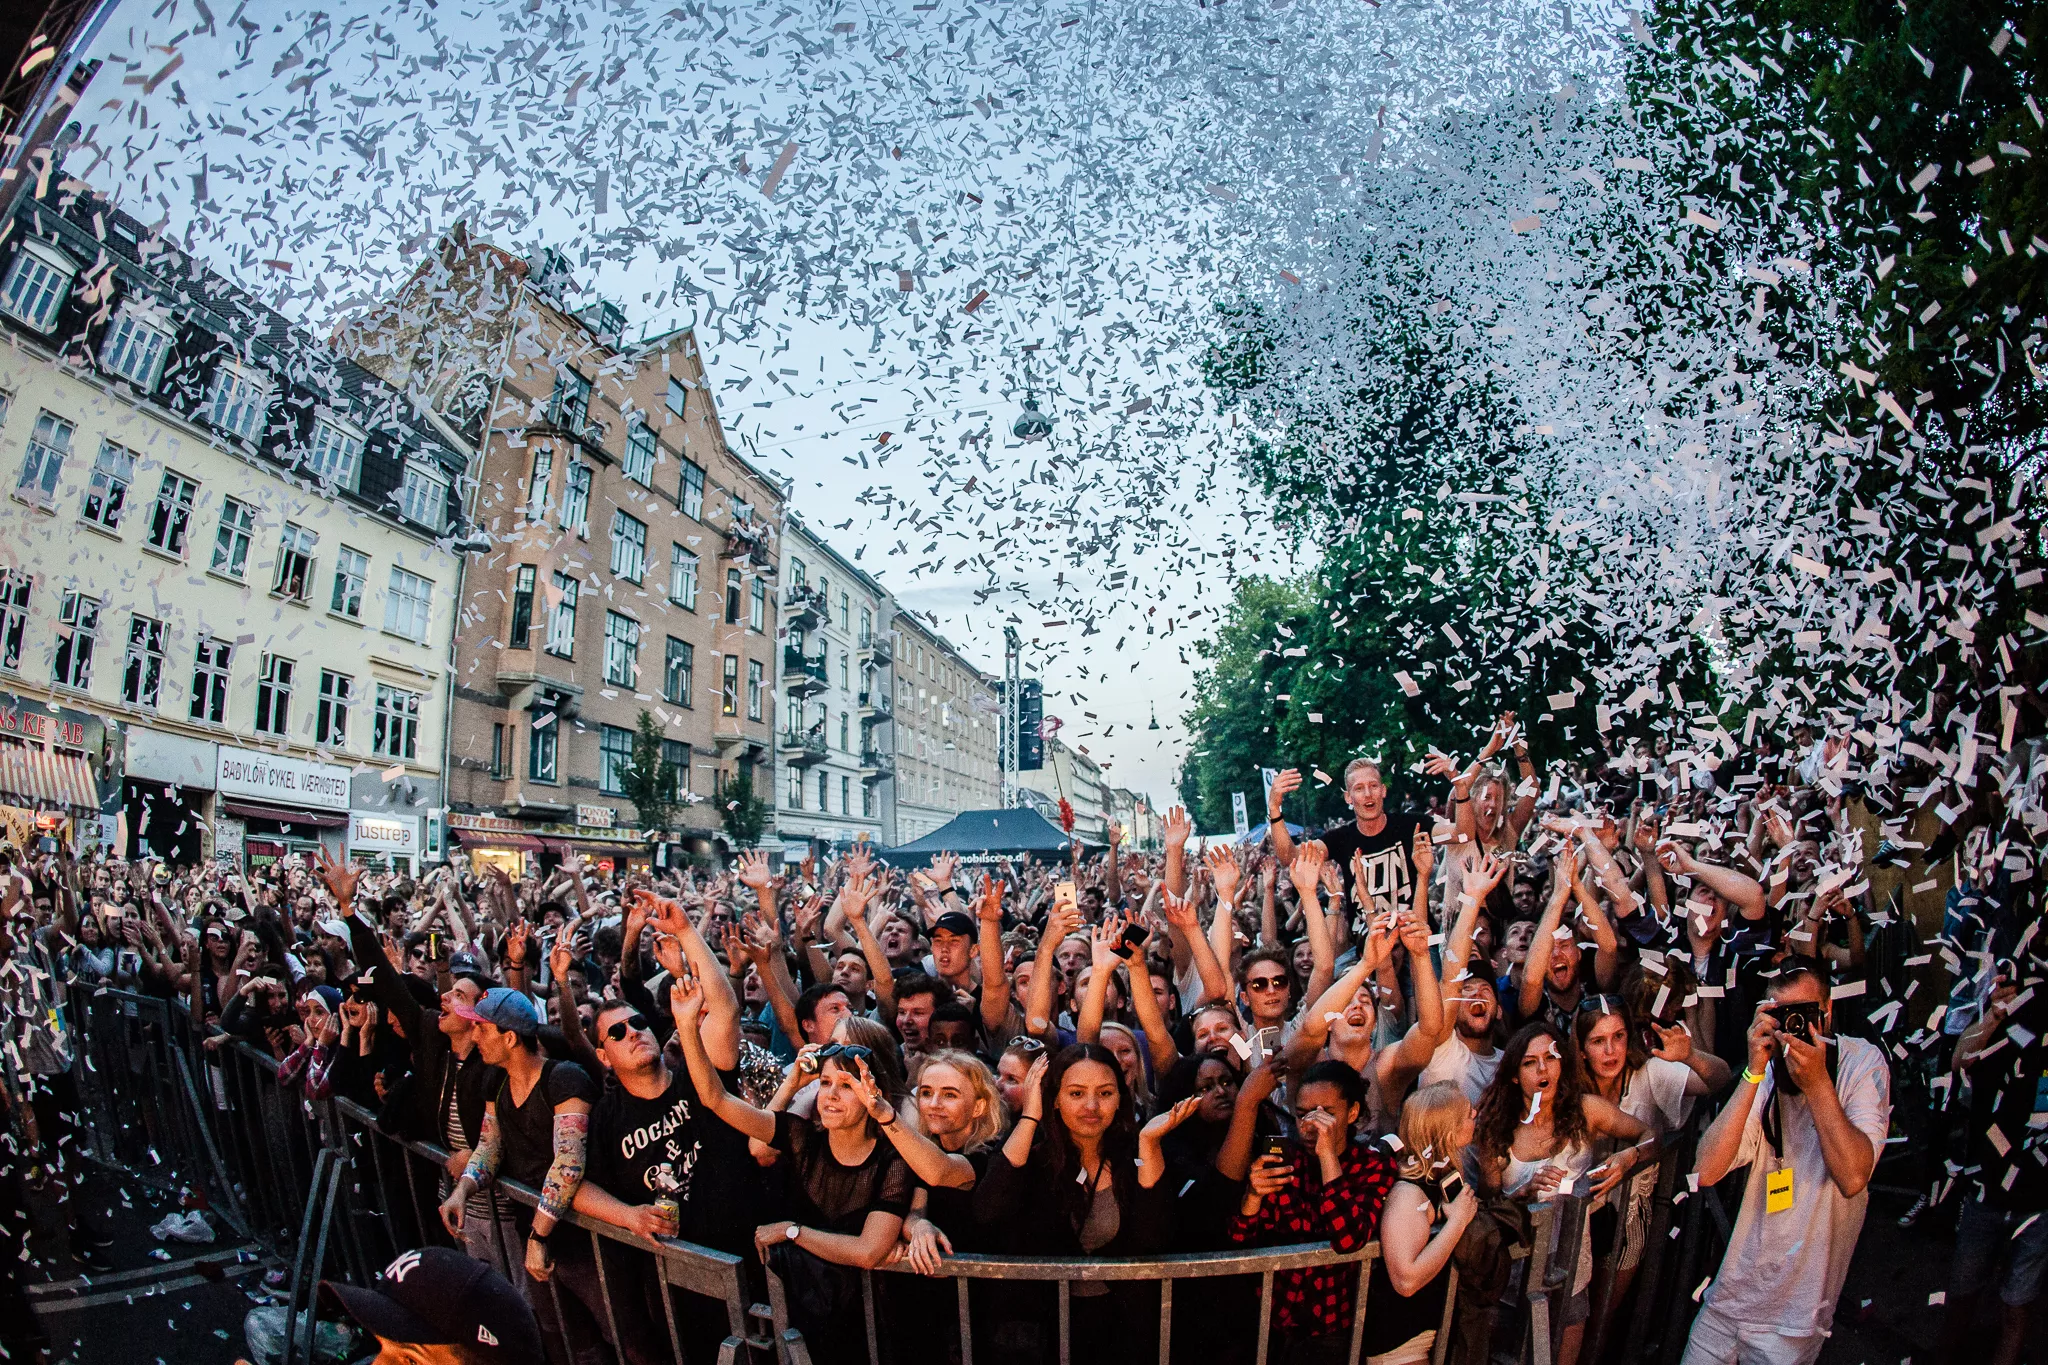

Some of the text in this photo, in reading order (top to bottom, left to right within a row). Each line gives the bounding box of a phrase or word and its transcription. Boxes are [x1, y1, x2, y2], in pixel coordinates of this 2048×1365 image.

[222, 760, 266, 786] BABYLON
[269, 768, 296, 790] CYKEL
[447, 813, 486, 828] KONYA
[355, 820, 411, 845] justrep
[665, 1139, 681, 1161] &
[1769, 1185, 1789, 1195] PRESSE
